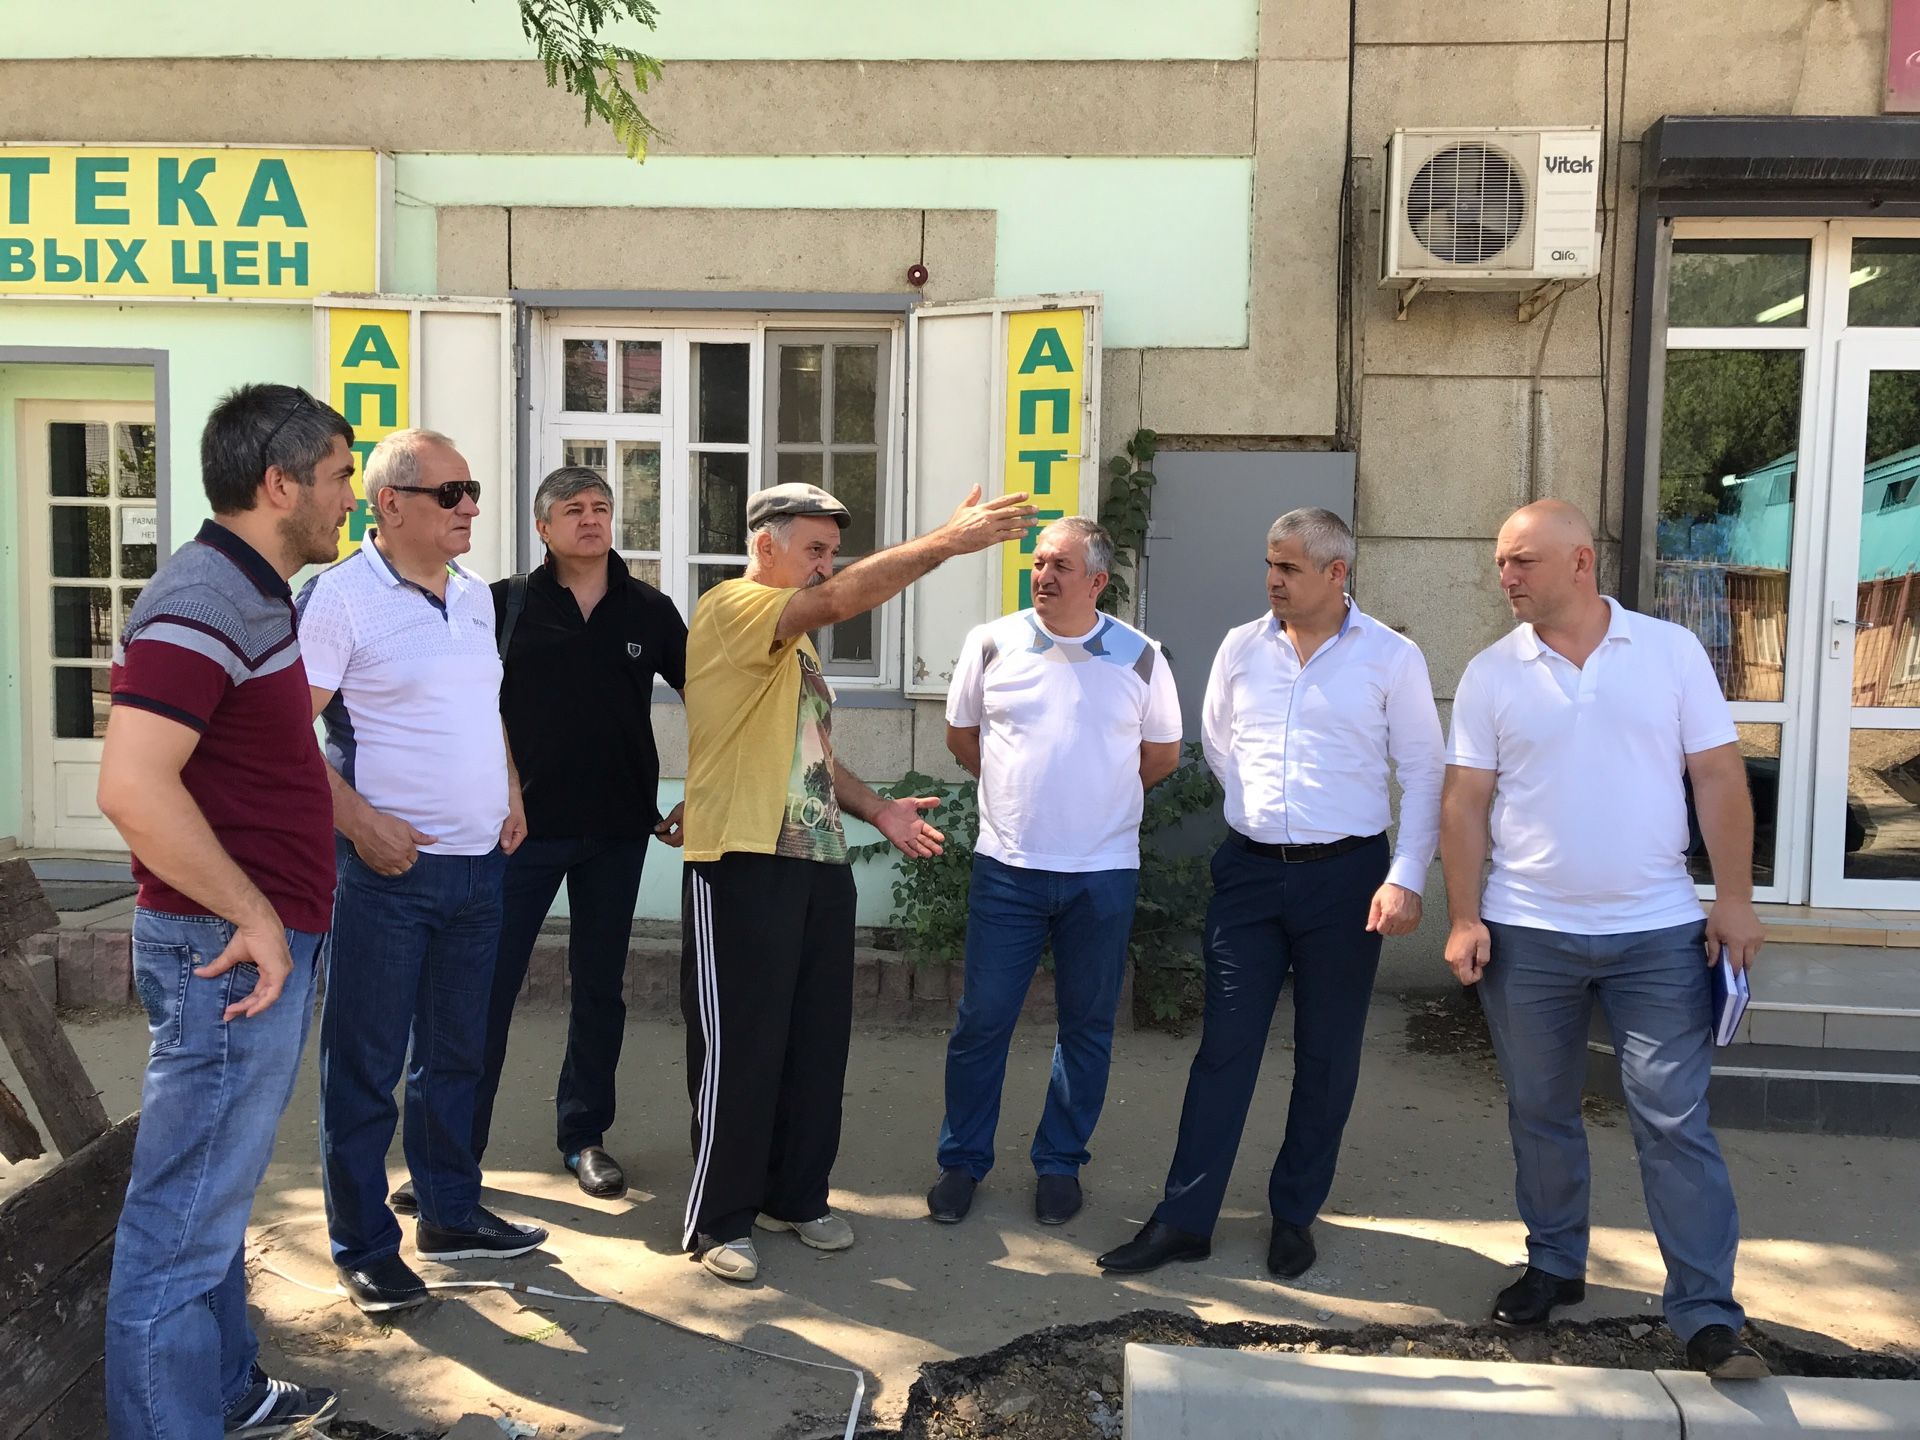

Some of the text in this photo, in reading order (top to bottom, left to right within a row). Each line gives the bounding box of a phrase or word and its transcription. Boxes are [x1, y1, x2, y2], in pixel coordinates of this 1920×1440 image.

[0, 157, 308, 228] ТЕКА
[1544, 155, 1595, 174] Vitek
[0, 237, 309, 294] ВЫХ ЦЕН
